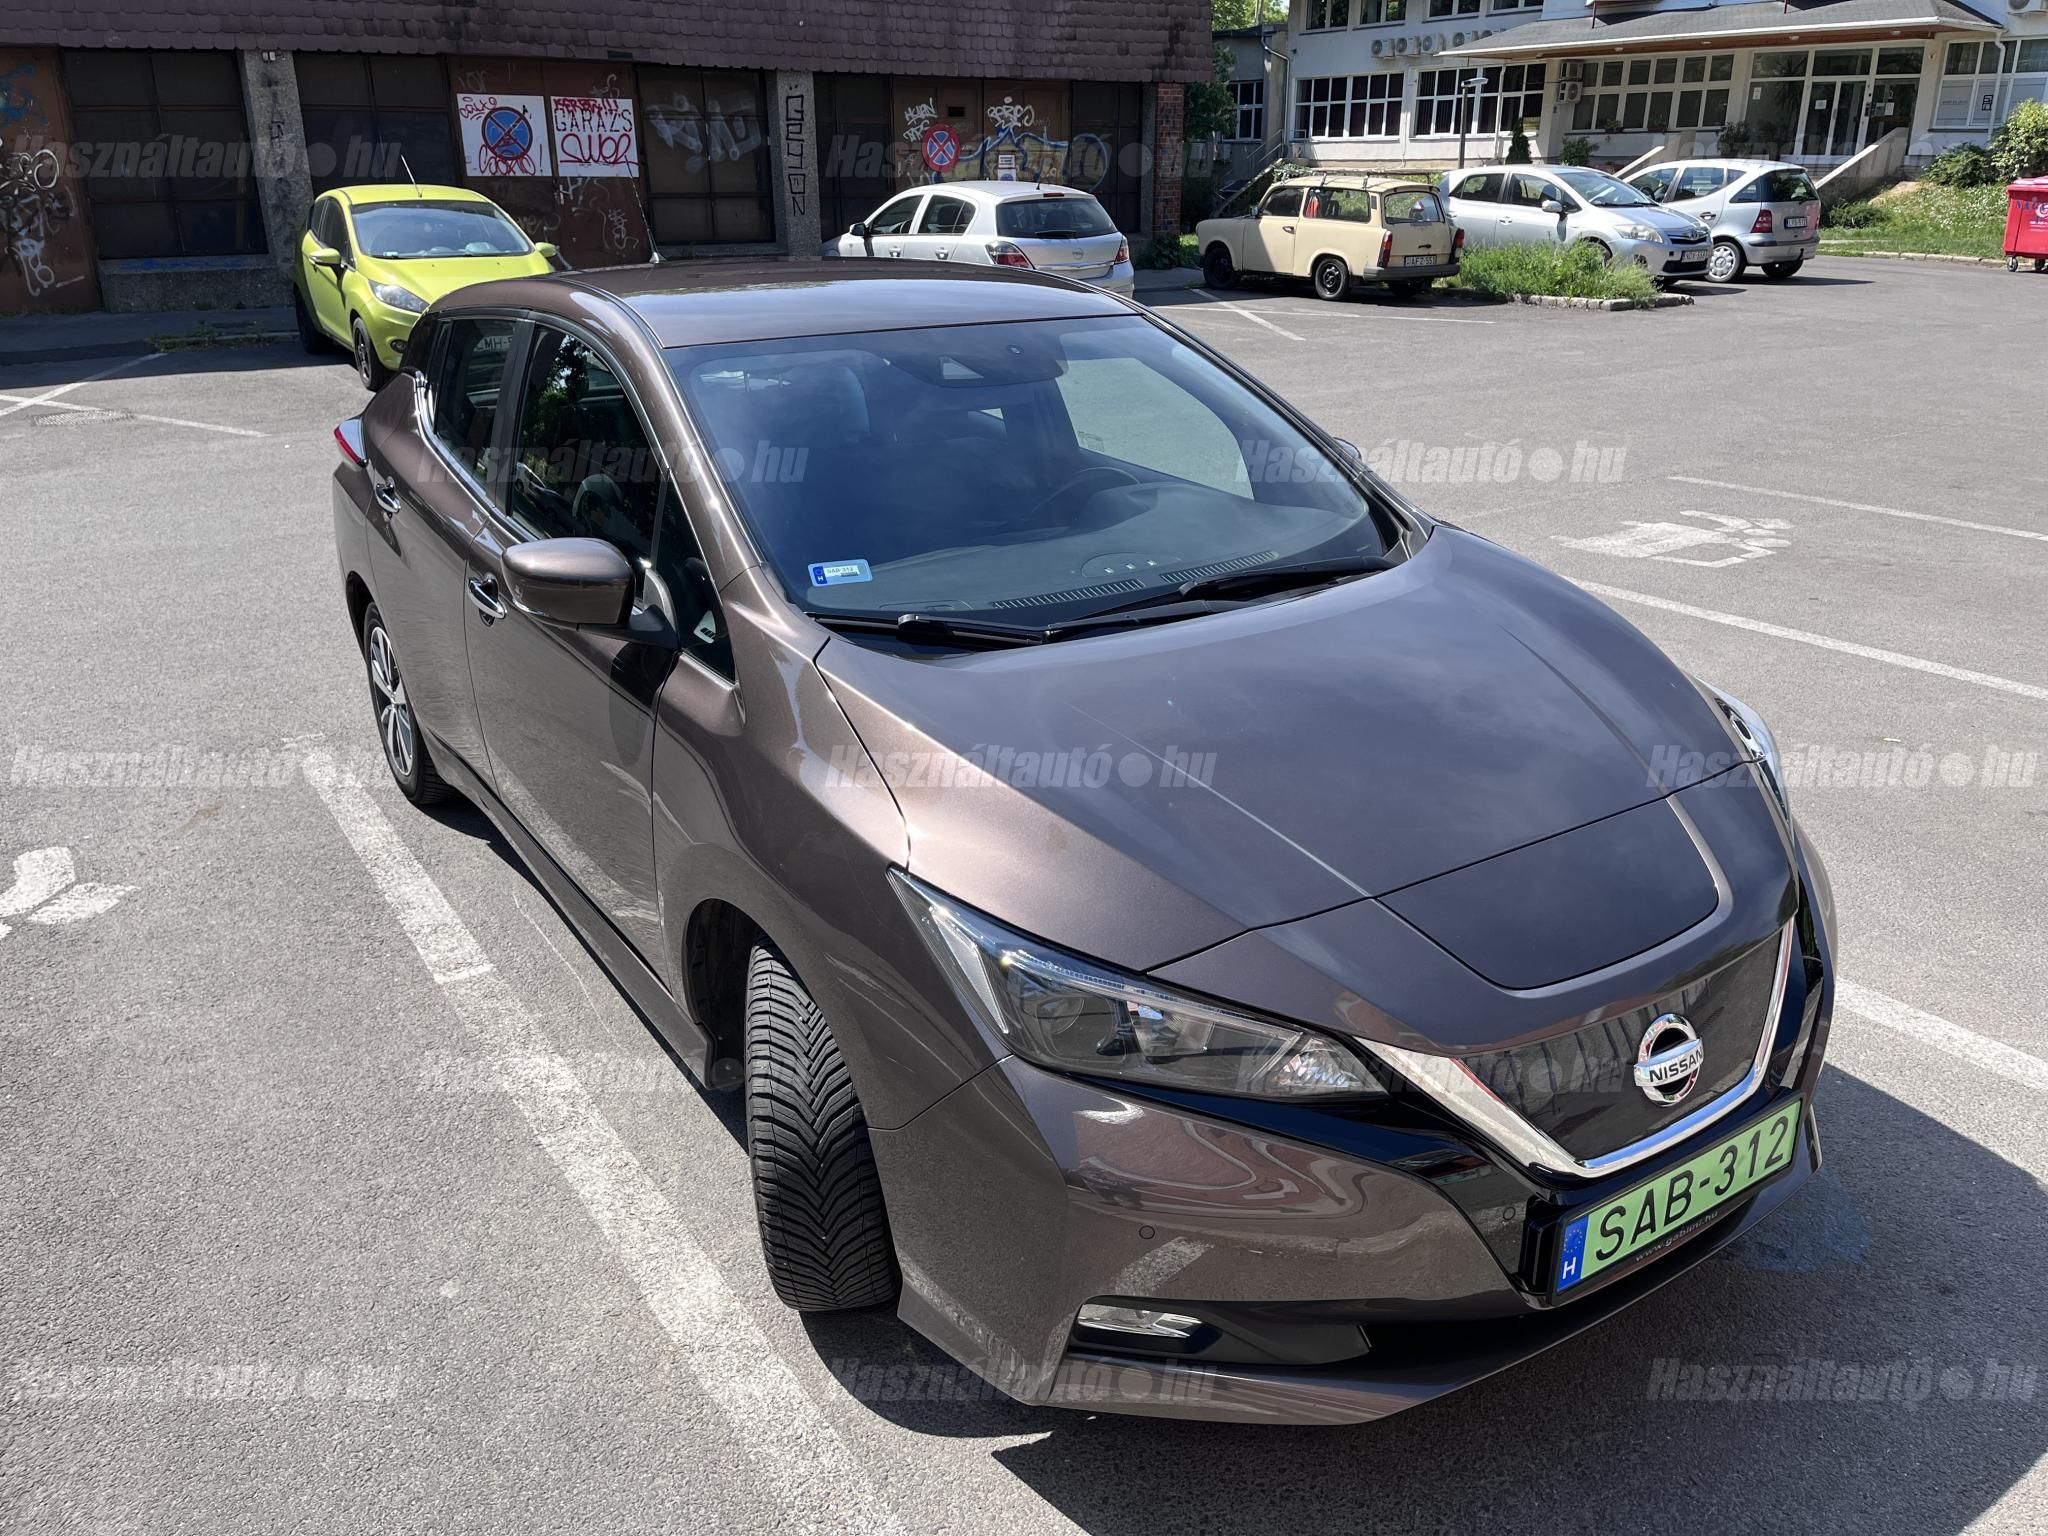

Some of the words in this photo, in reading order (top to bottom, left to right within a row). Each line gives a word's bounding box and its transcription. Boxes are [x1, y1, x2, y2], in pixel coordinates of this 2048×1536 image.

[1649, 1048, 1702, 1083] NISSAN
[1595, 1115, 1789, 1261] SAB-312
[1562, 1257, 1577, 1280] H
